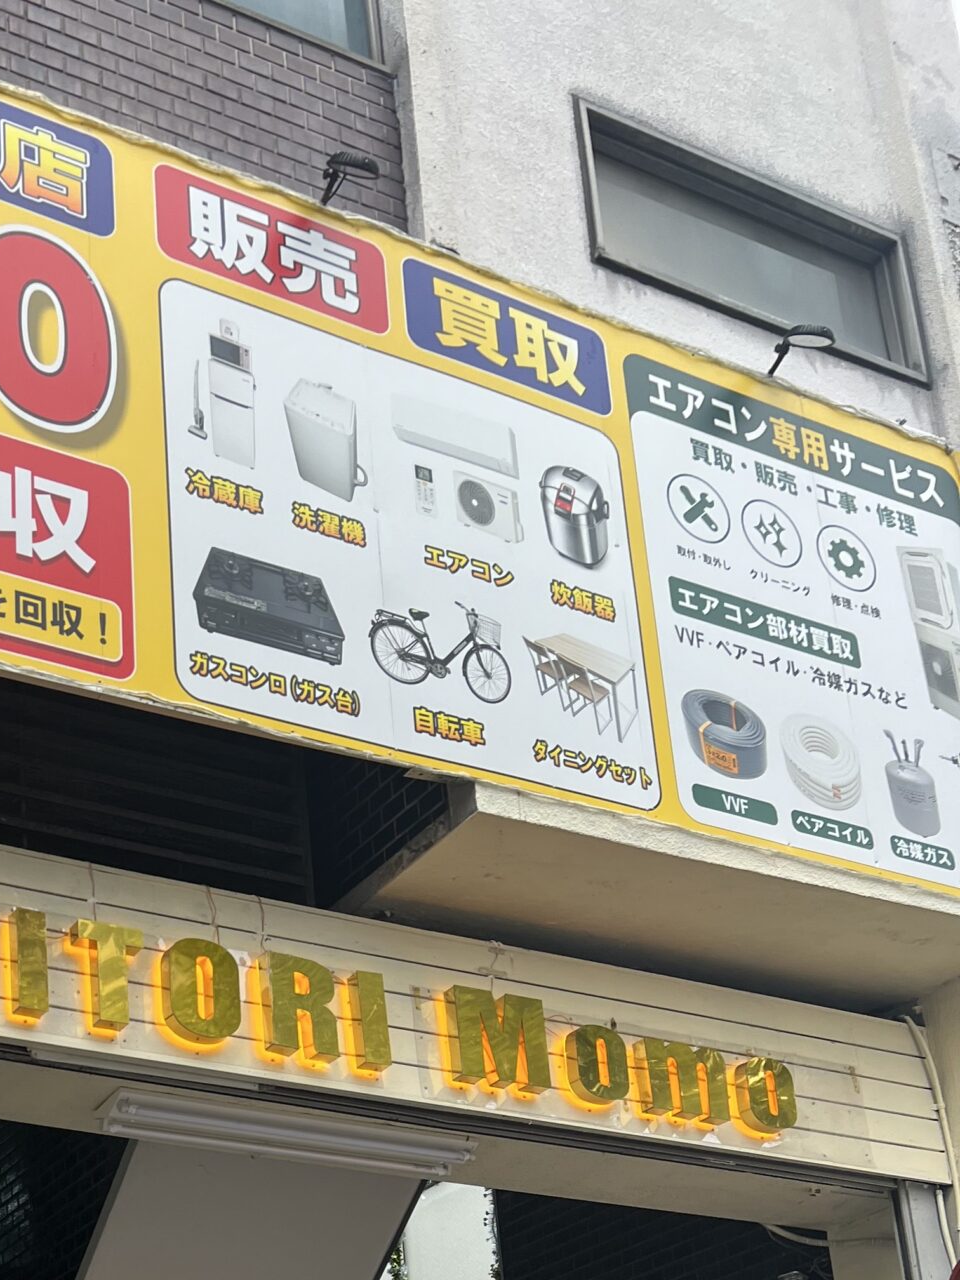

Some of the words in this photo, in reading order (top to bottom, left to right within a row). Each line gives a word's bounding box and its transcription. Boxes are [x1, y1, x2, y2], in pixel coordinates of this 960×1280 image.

[188, 186, 361, 315] 販売
[433, 277, 586, 398] 買取
[647, 373, 946, 507] エアコン専用サービス
[185, 468, 263, 515] 冷蔵庫
[690, 437, 918, 536] 買取・販売・工事・修理
[292, 502, 367, 547] 洗濯機
[424, 545, 514, 586] エアコン
[750, 569, 811, 596] クリーニング
[550, 580, 616, 623] 炊飯器
[678, 588, 854, 661] エアコン部材買取
[414, 706, 485, 747] 自転車
[532, 739, 653, 789] ダイニングセット
[721, 793, 750, 814] VVF
[795, 815, 870, 846] ペアコイル
[894, 838, 952, 866] 冷媒ガス
